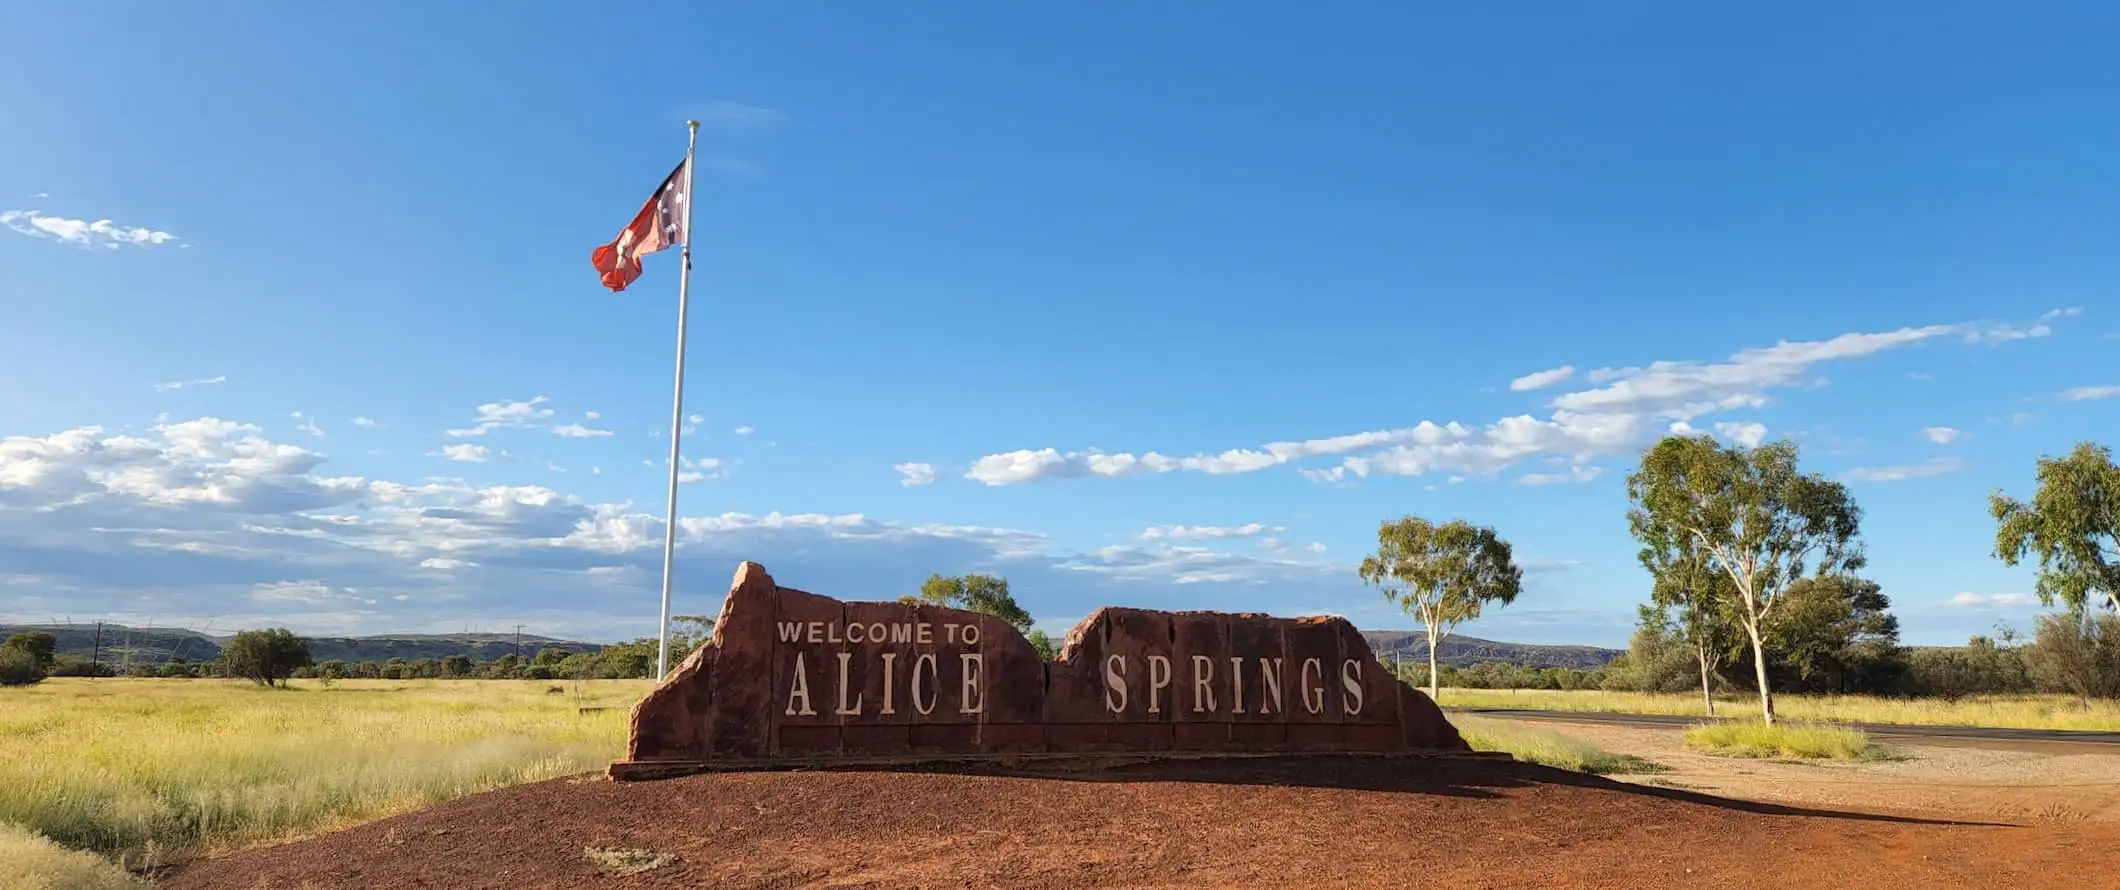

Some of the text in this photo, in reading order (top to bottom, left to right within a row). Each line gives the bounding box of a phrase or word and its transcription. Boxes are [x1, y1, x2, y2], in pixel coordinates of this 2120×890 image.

[778, 622, 980, 645] WELCOME TO
[785, 653, 1364, 716] ALICE SPRINGS
